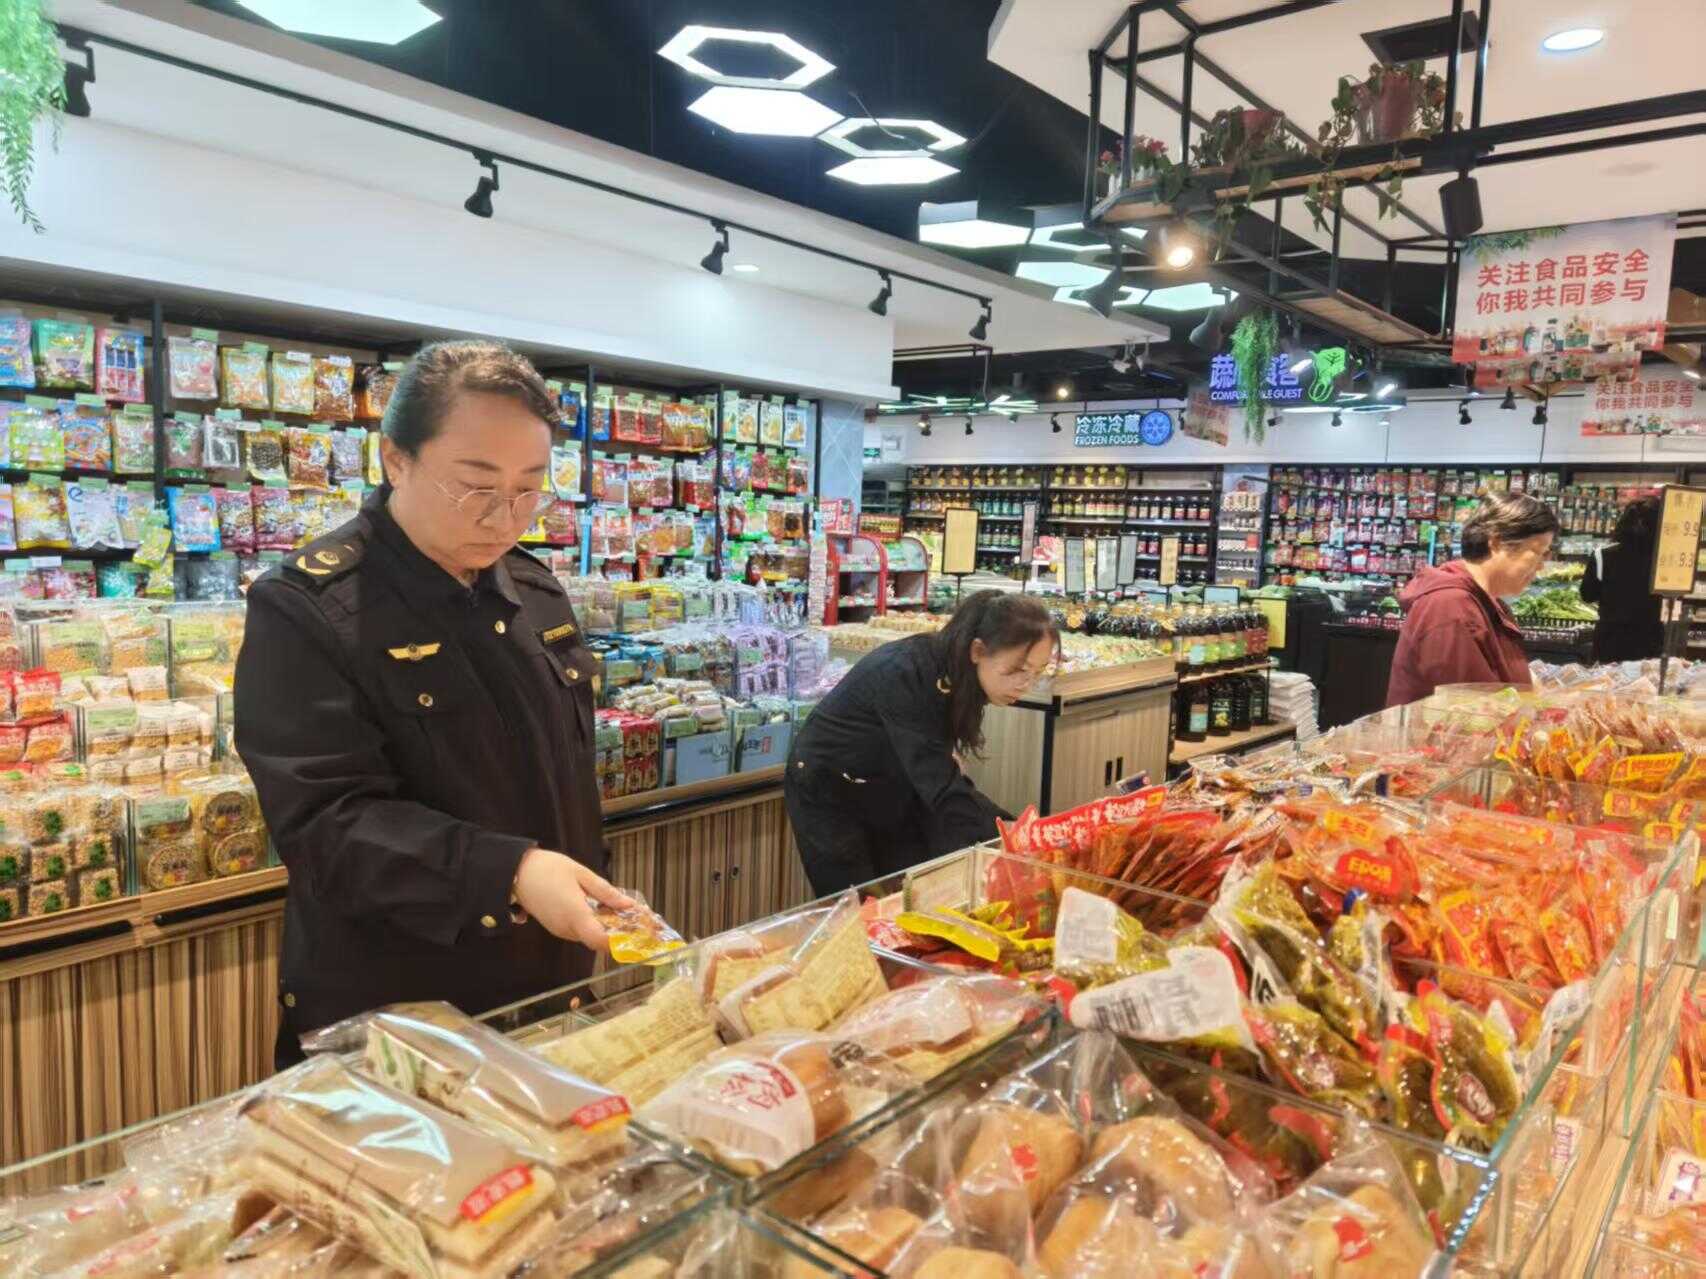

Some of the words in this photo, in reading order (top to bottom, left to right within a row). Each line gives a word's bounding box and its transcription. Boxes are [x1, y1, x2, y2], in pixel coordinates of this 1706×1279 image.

[1477, 248, 1649, 288] 关注食品安全
[1475, 278, 1648, 315] 你我共同参与
[1273, 388, 1303, 399] GUEST
[1076, 414, 1140, 434] 冷冻冷藏
[1075, 436, 1108, 445] FROZEN
[1109, 434, 1139, 445] FOODS
